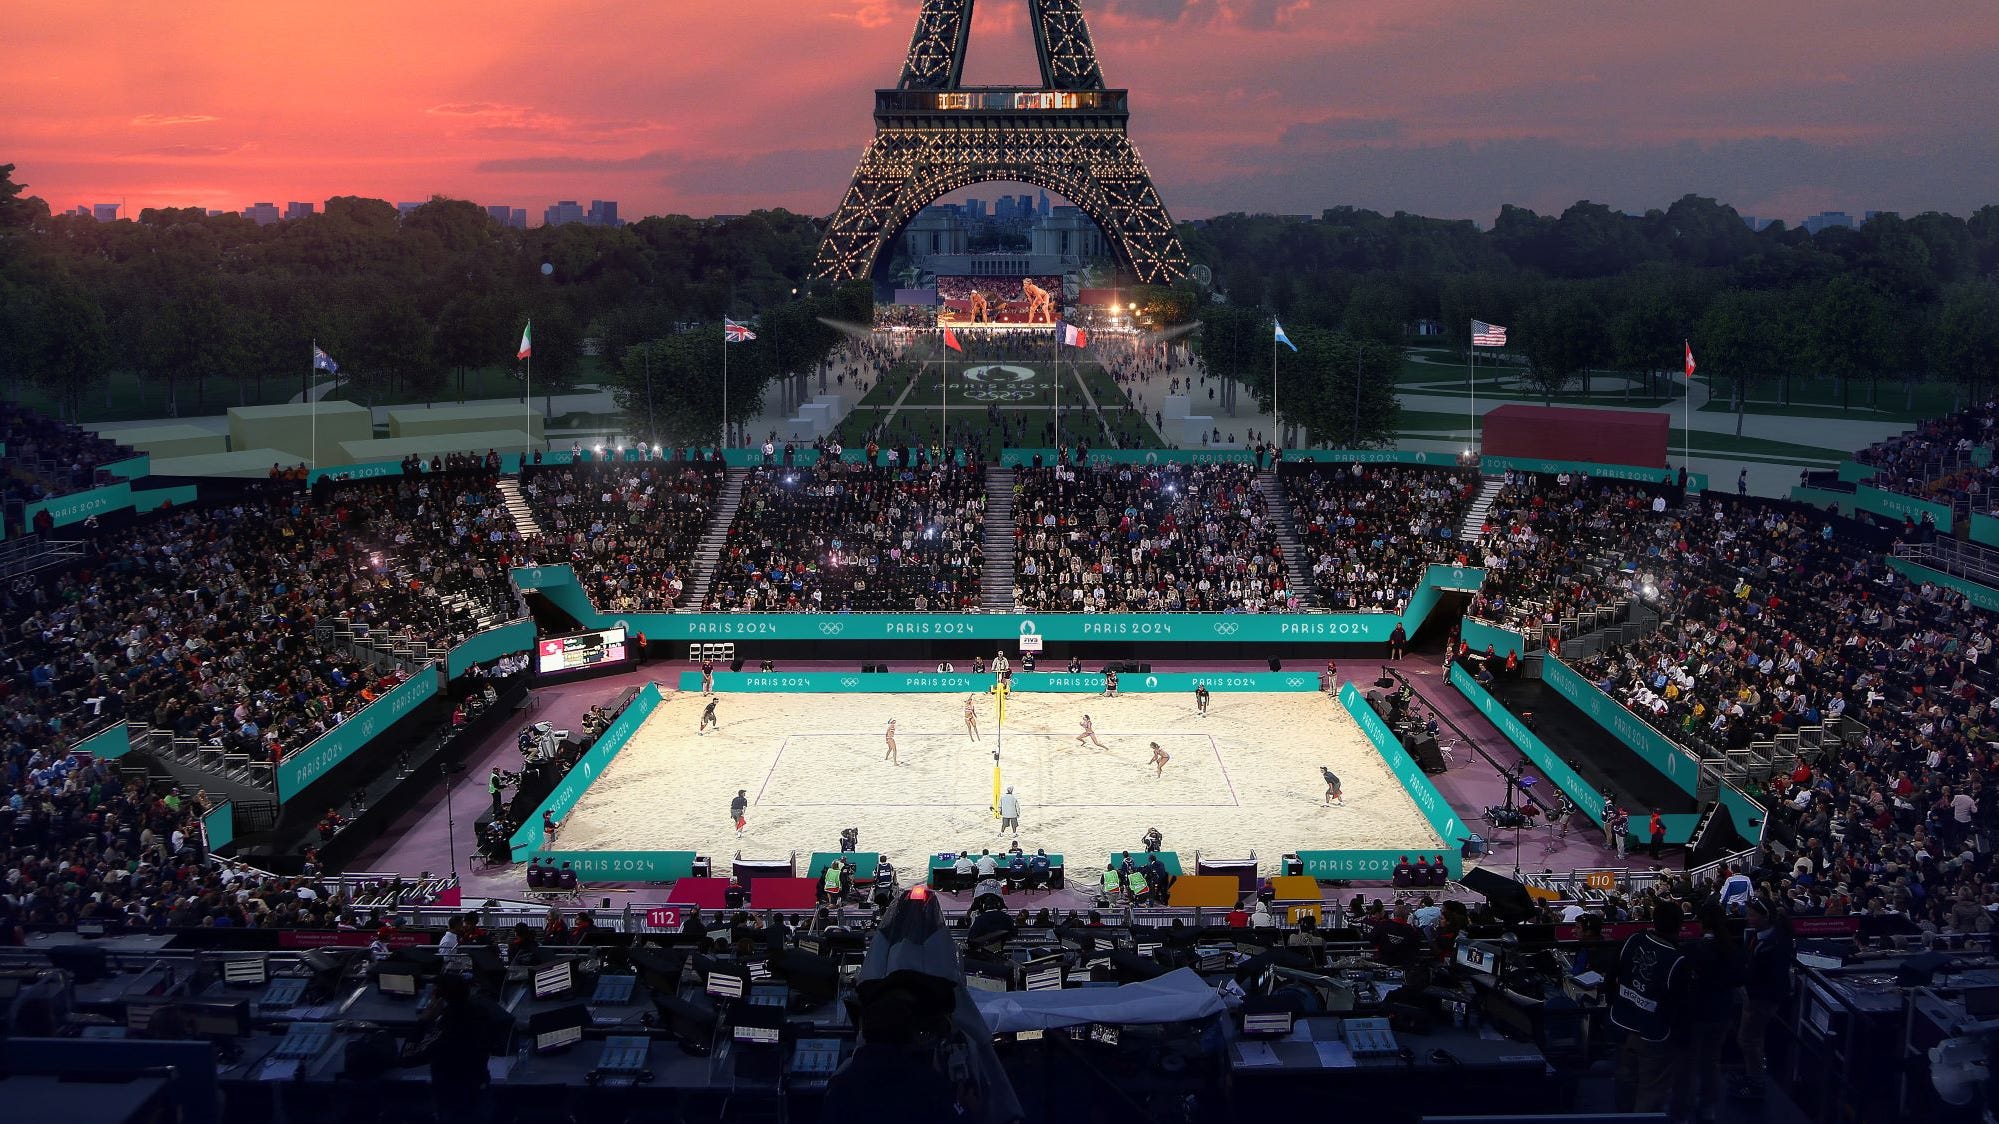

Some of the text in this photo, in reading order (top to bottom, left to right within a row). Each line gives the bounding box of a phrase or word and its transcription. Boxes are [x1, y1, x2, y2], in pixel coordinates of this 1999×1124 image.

[1193, 454, 1222, 462] PARIS
[1336, 454, 1398, 462] PARIS 2024
[1597, 468, 1654, 481] PARIS 2024
[689, 623, 776, 633] PARIS 2024
[886, 623, 973, 633] PARIS 2024
[1084, 623, 1171, 633] PARIS 2024
[1281, 623, 1368, 633] PARIS 2024
[747, 678, 810, 686] PARIS 2024
[906, 678, 970, 686] PARIS 2024
[1049, 678, 1106, 686] PARIS 202
[1192, 678, 1255, 686] PARIS 2024
[1614, 715, 1649, 753] PARIS 2024
[297, 743, 343, 785] PARIS 2024
[573, 860, 654, 870] ARIS 2024
[1309, 860, 1353, 870] PARIS
[1590, 874, 1609, 886] 110
[652, 911, 675, 924] 112
